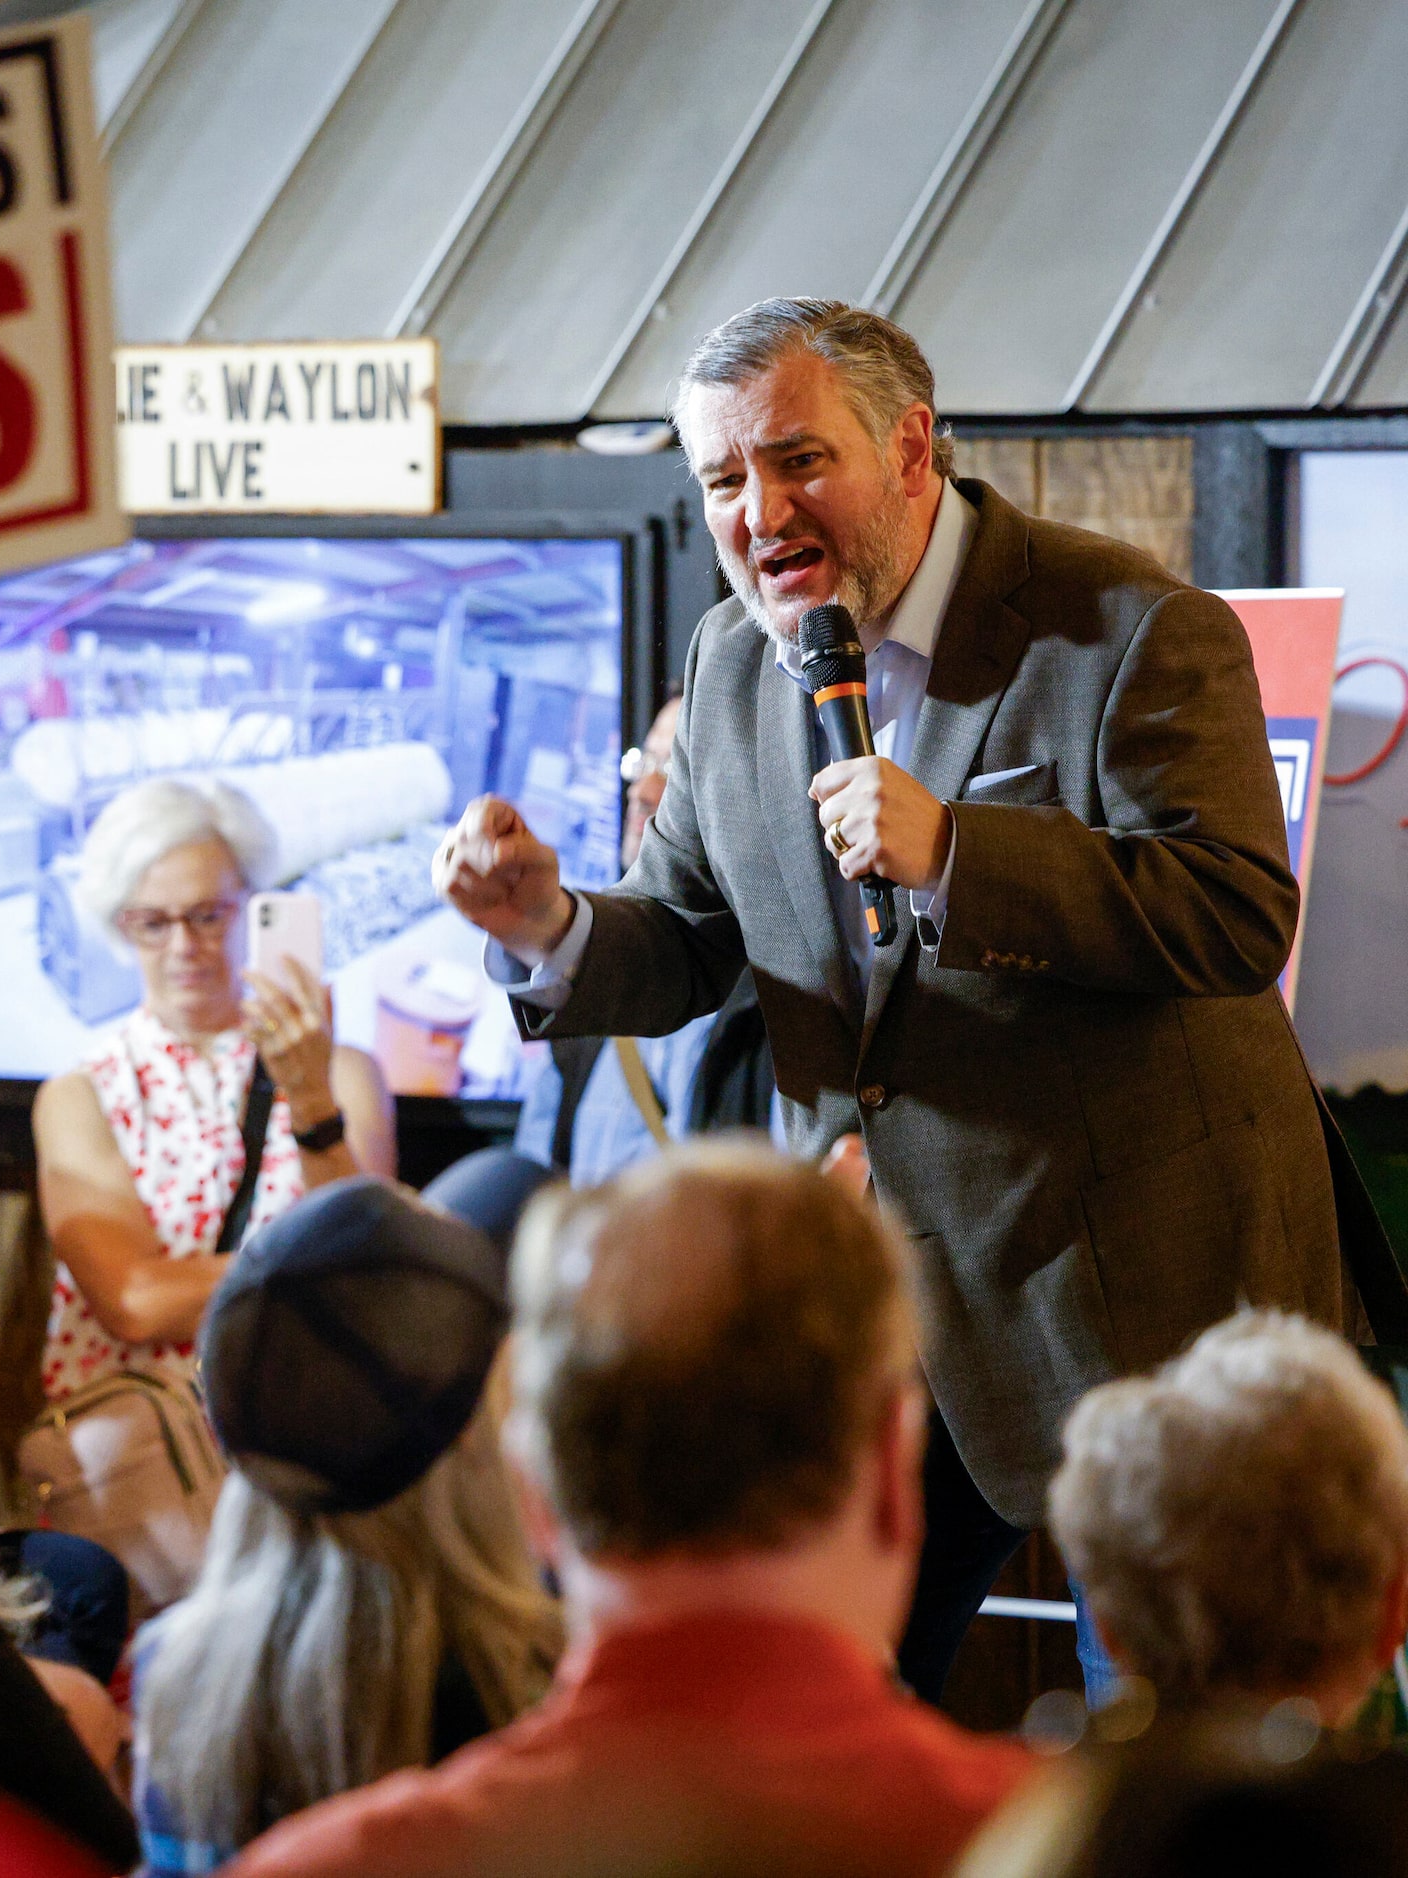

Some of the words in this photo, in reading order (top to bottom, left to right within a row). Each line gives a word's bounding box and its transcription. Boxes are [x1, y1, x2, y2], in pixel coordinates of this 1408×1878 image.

[184, 367, 207, 415] &
[222, 361, 412, 423] WAYLON
[169, 440, 264, 500] LIVE
